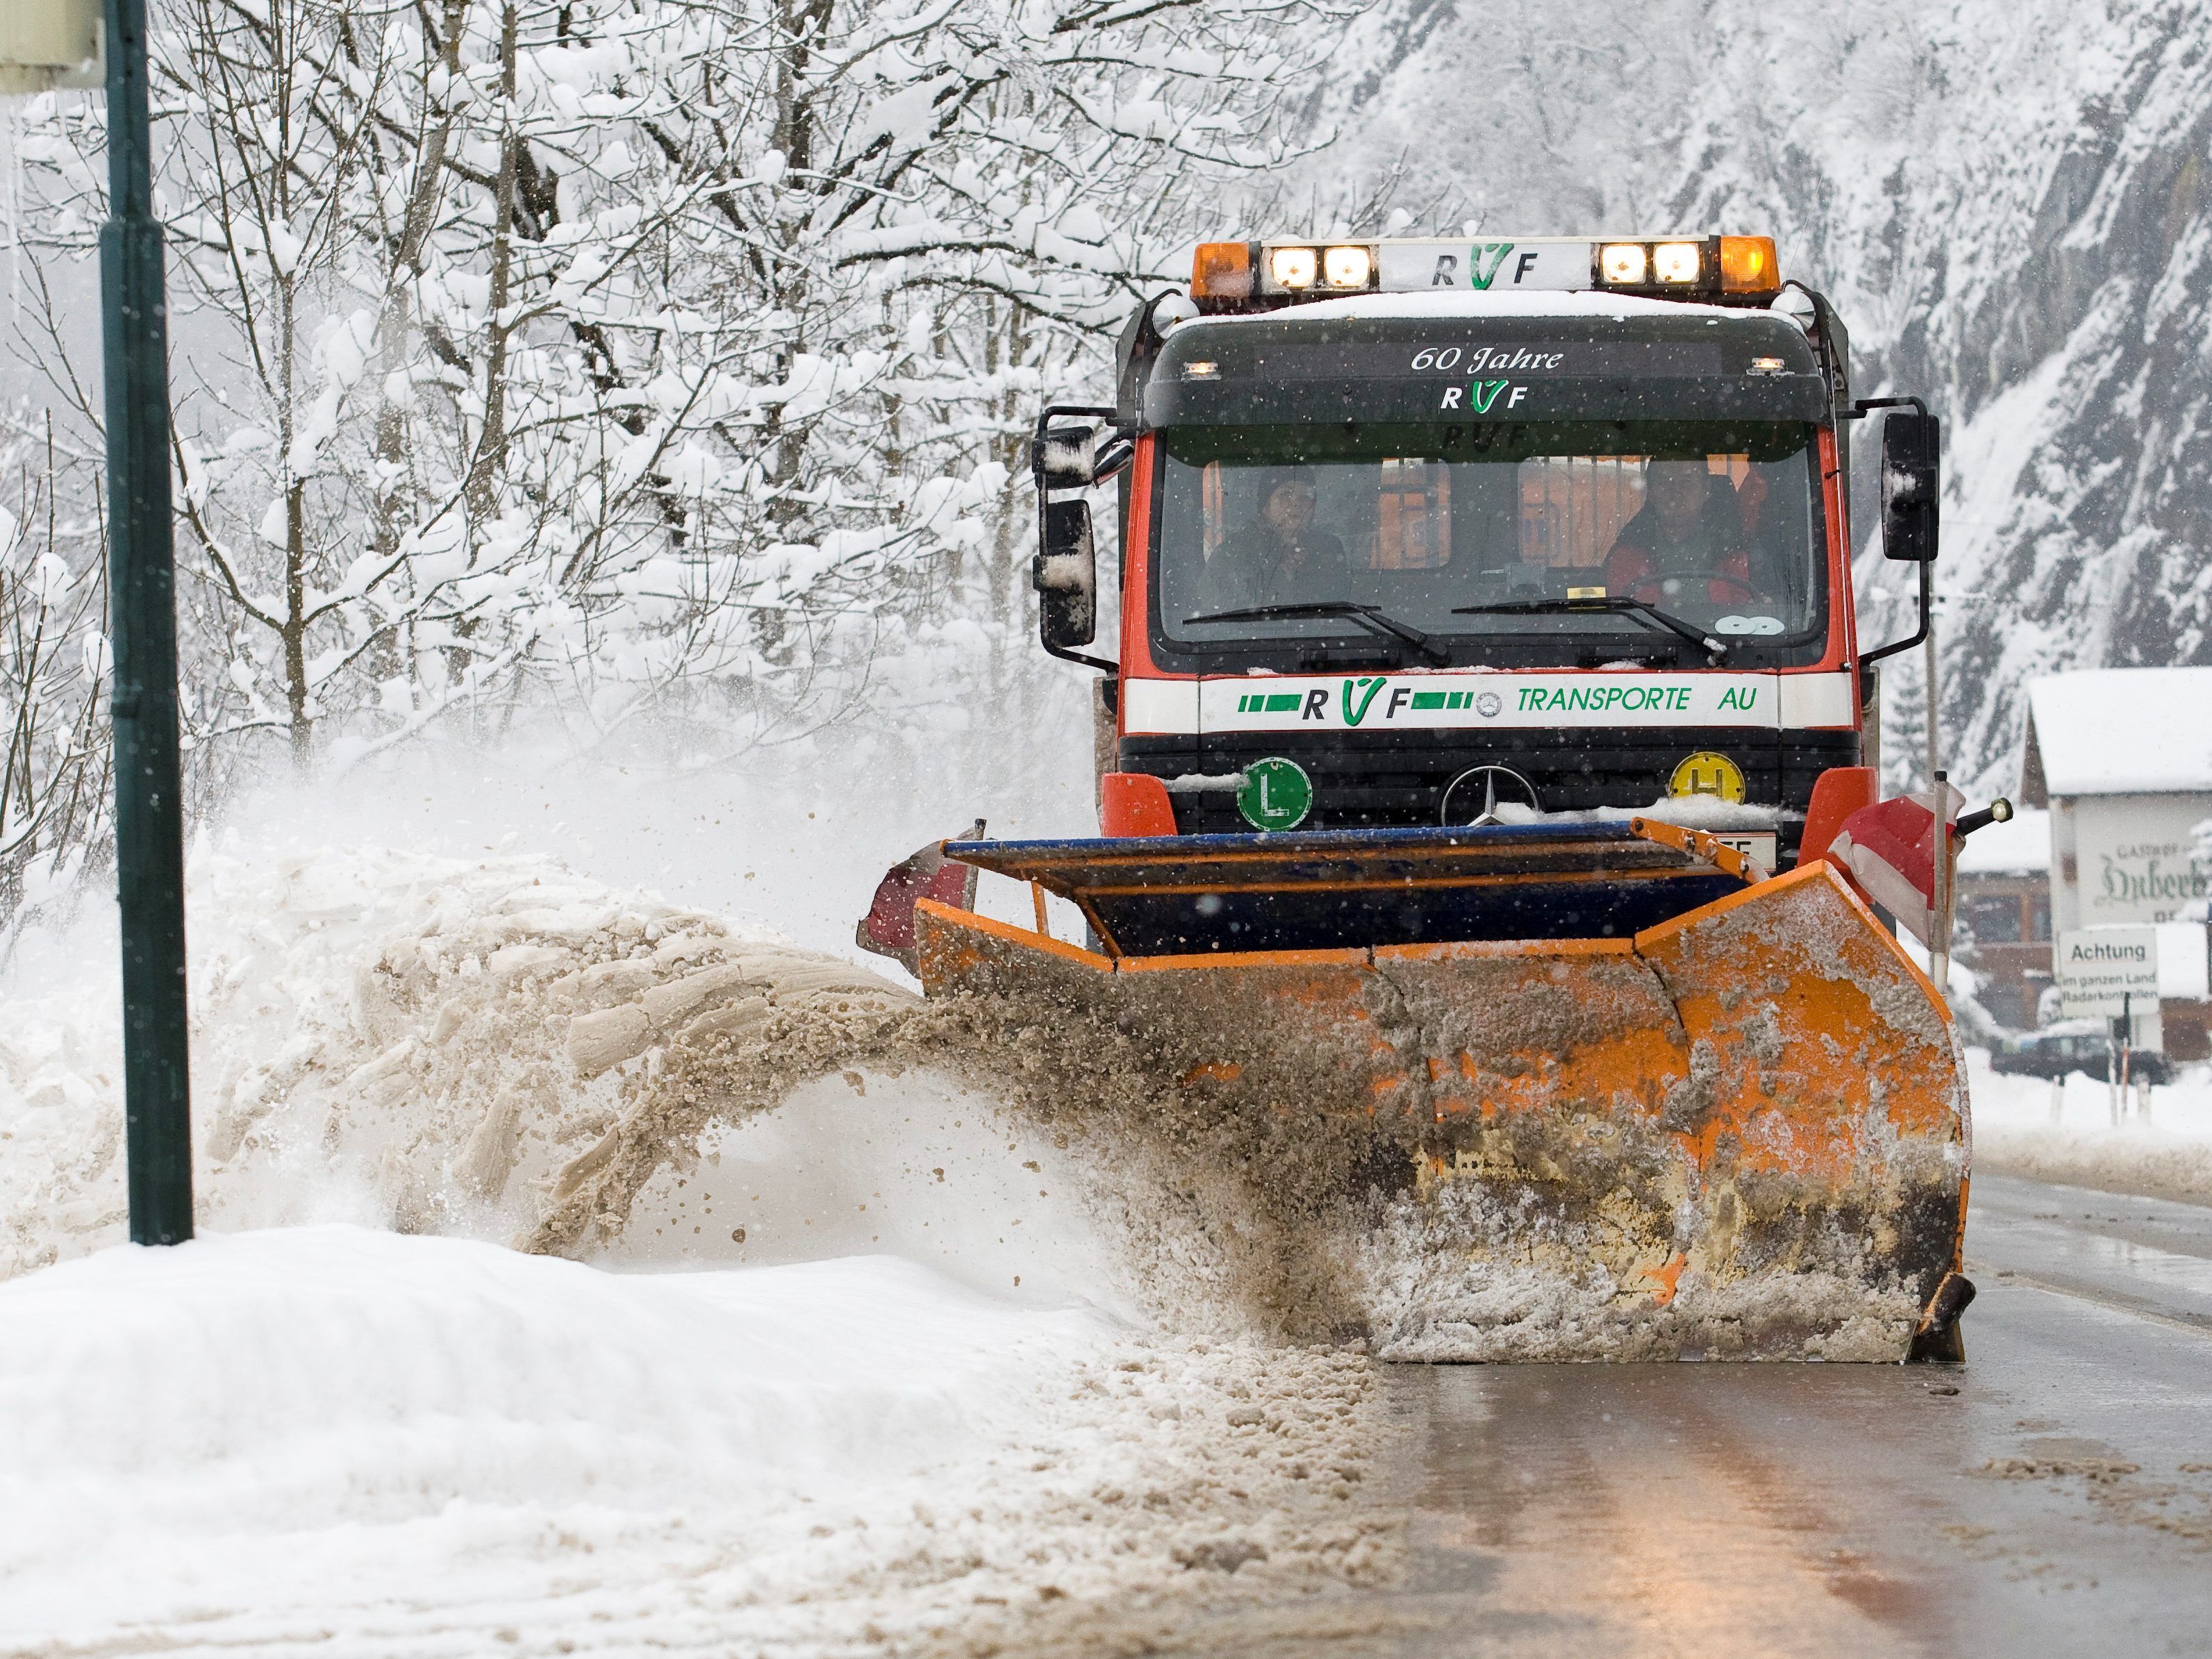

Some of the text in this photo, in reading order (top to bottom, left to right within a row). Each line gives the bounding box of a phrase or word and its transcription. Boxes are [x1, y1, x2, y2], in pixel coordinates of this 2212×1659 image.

[1411, 347, 1564, 374] 60 Jahre
[1518, 687, 1692, 710] TRANSPORTE
[1718, 687, 1757, 710] AU
[1691, 768, 1722, 798] H
[1260, 773, 1290, 817] L
[2071, 944, 2146, 962] Achtung
[2126, 972, 2156, 984] Land
[2062, 989, 2159, 1003] Radarkontollen
